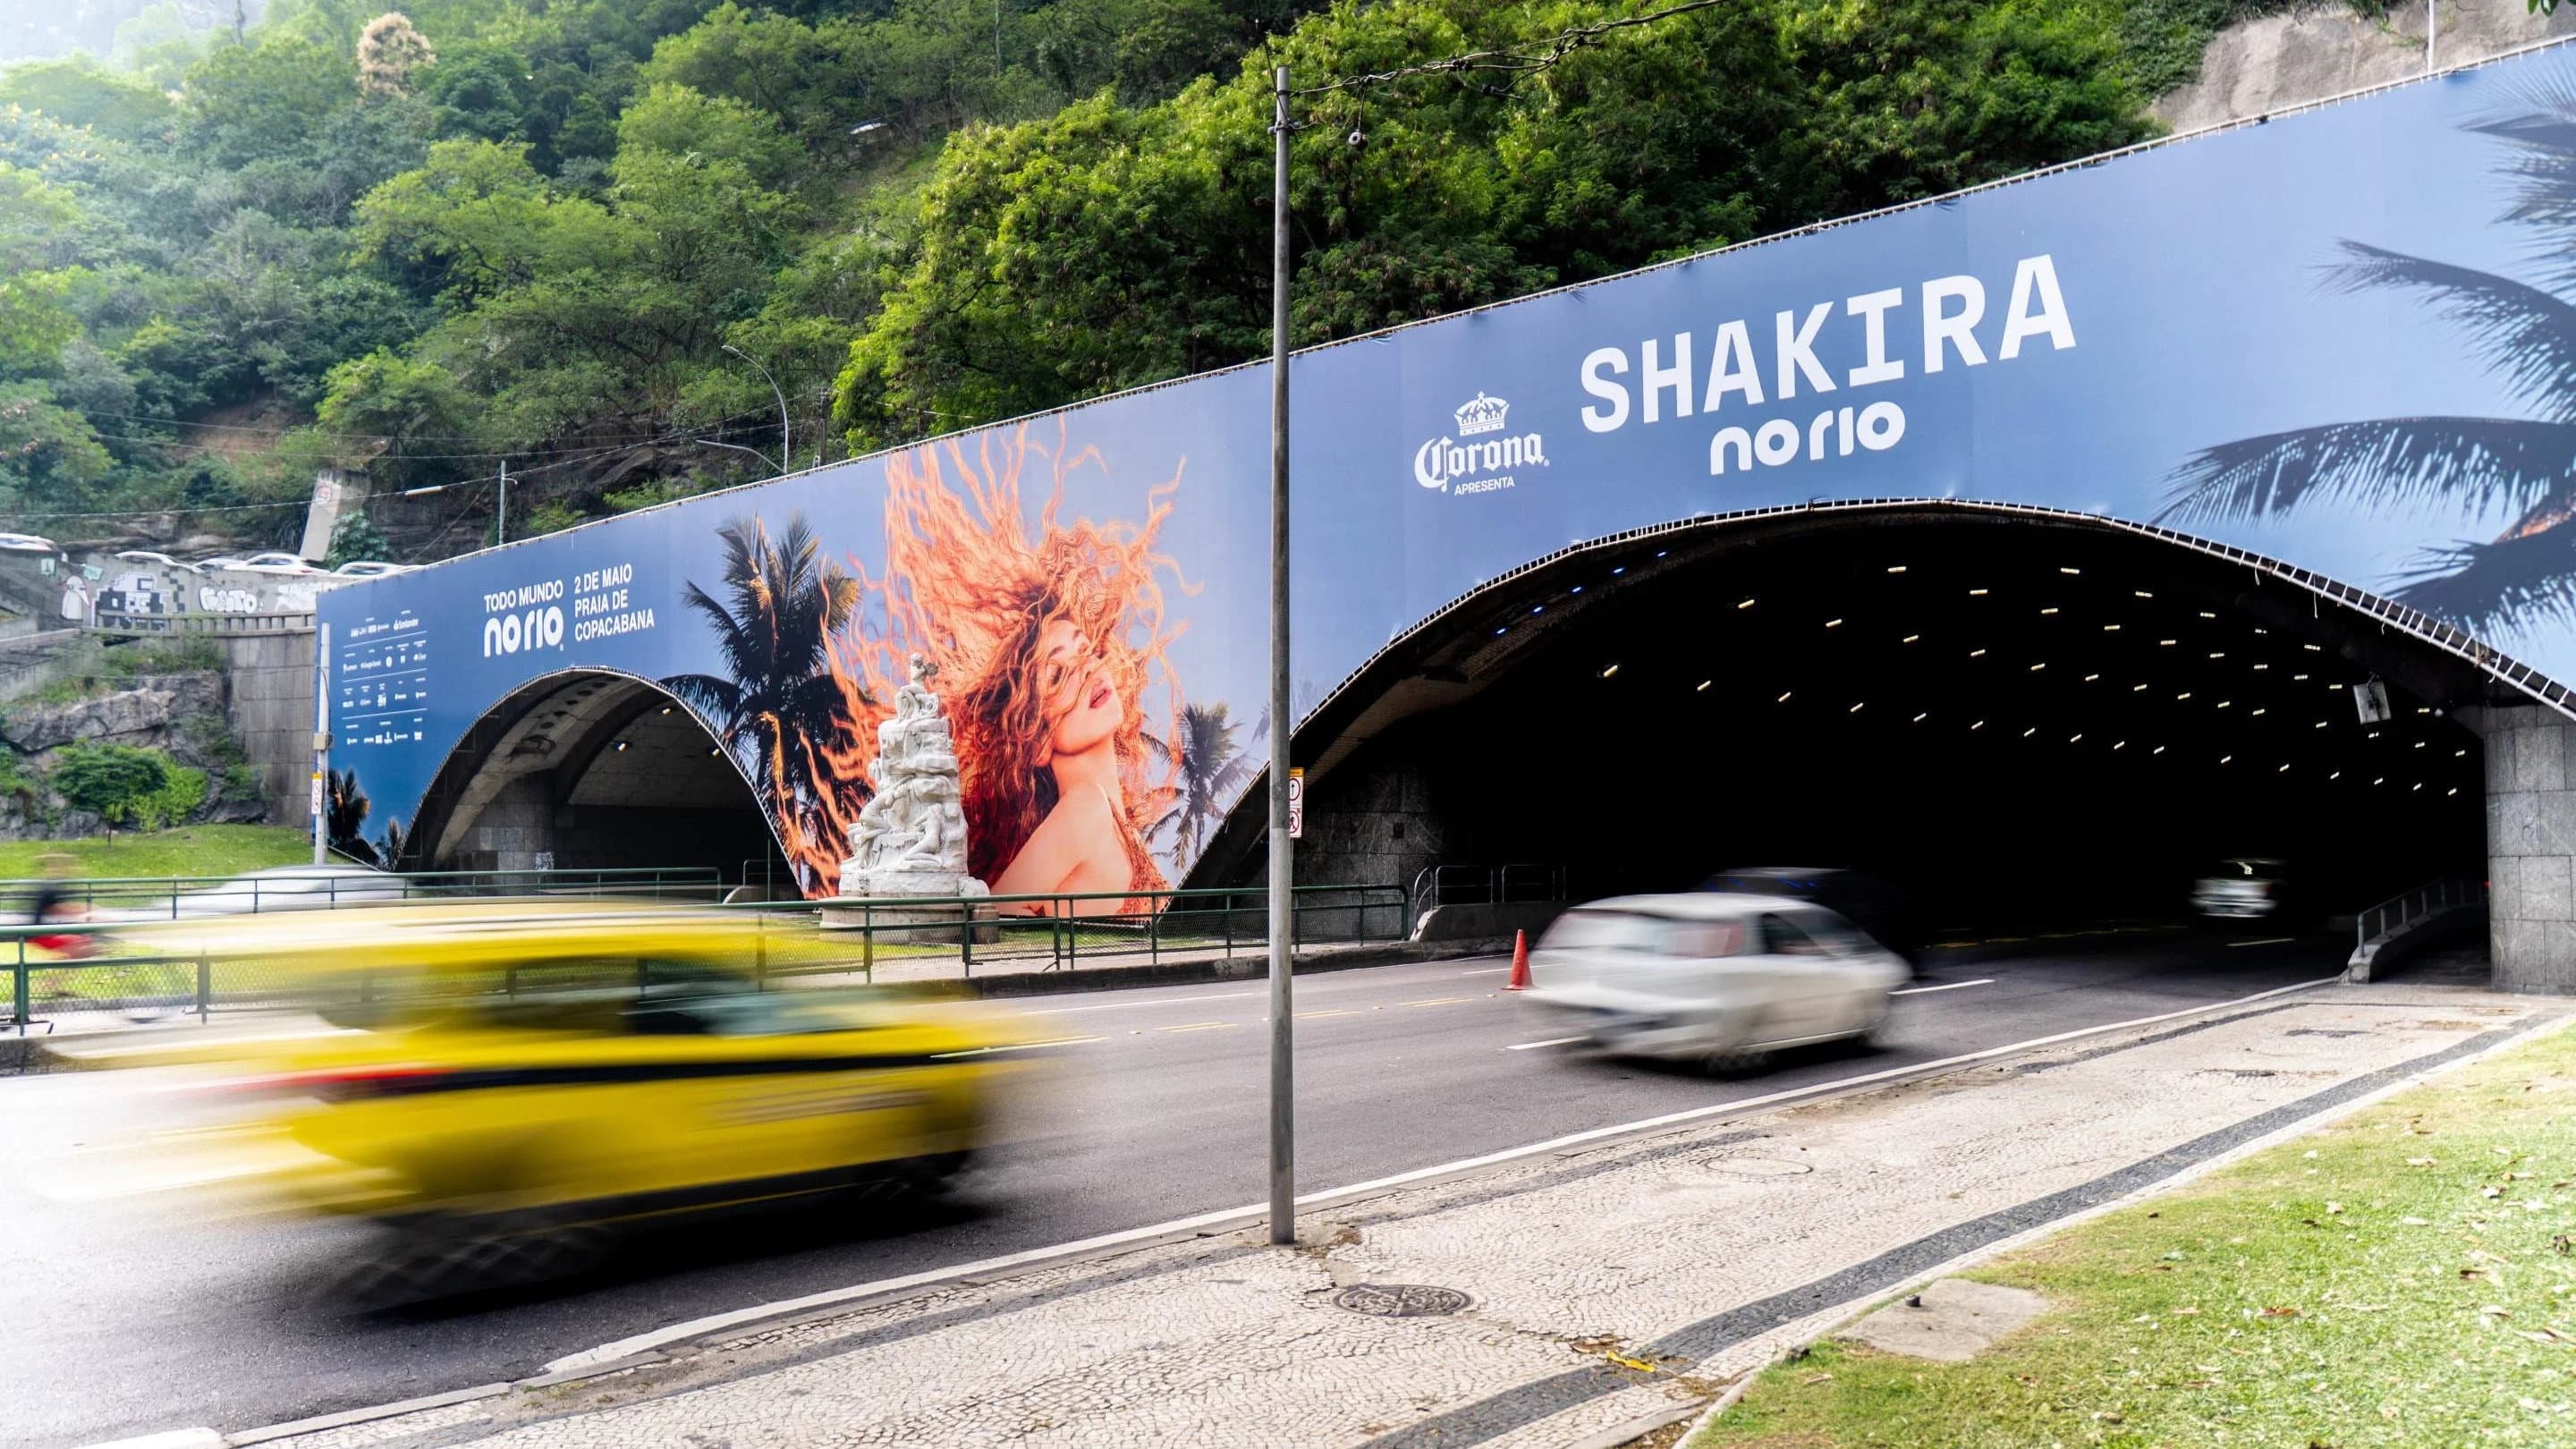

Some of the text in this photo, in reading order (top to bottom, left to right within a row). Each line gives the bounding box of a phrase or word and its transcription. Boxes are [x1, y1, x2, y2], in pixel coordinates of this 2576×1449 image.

[1580, 254, 2076, 434] SHAKIRA
[1414, 432, 1546, 492] Corona
[1453, 476, 1515, 496] APRESENTA
[574, 563, 632, 594] 2 DE MAIO
[484, 580, 564, 613] TODO MUNDO
[574, 589, 628, 618] PRAIA DE
[574, 608, 655, 641] COPACABANA
